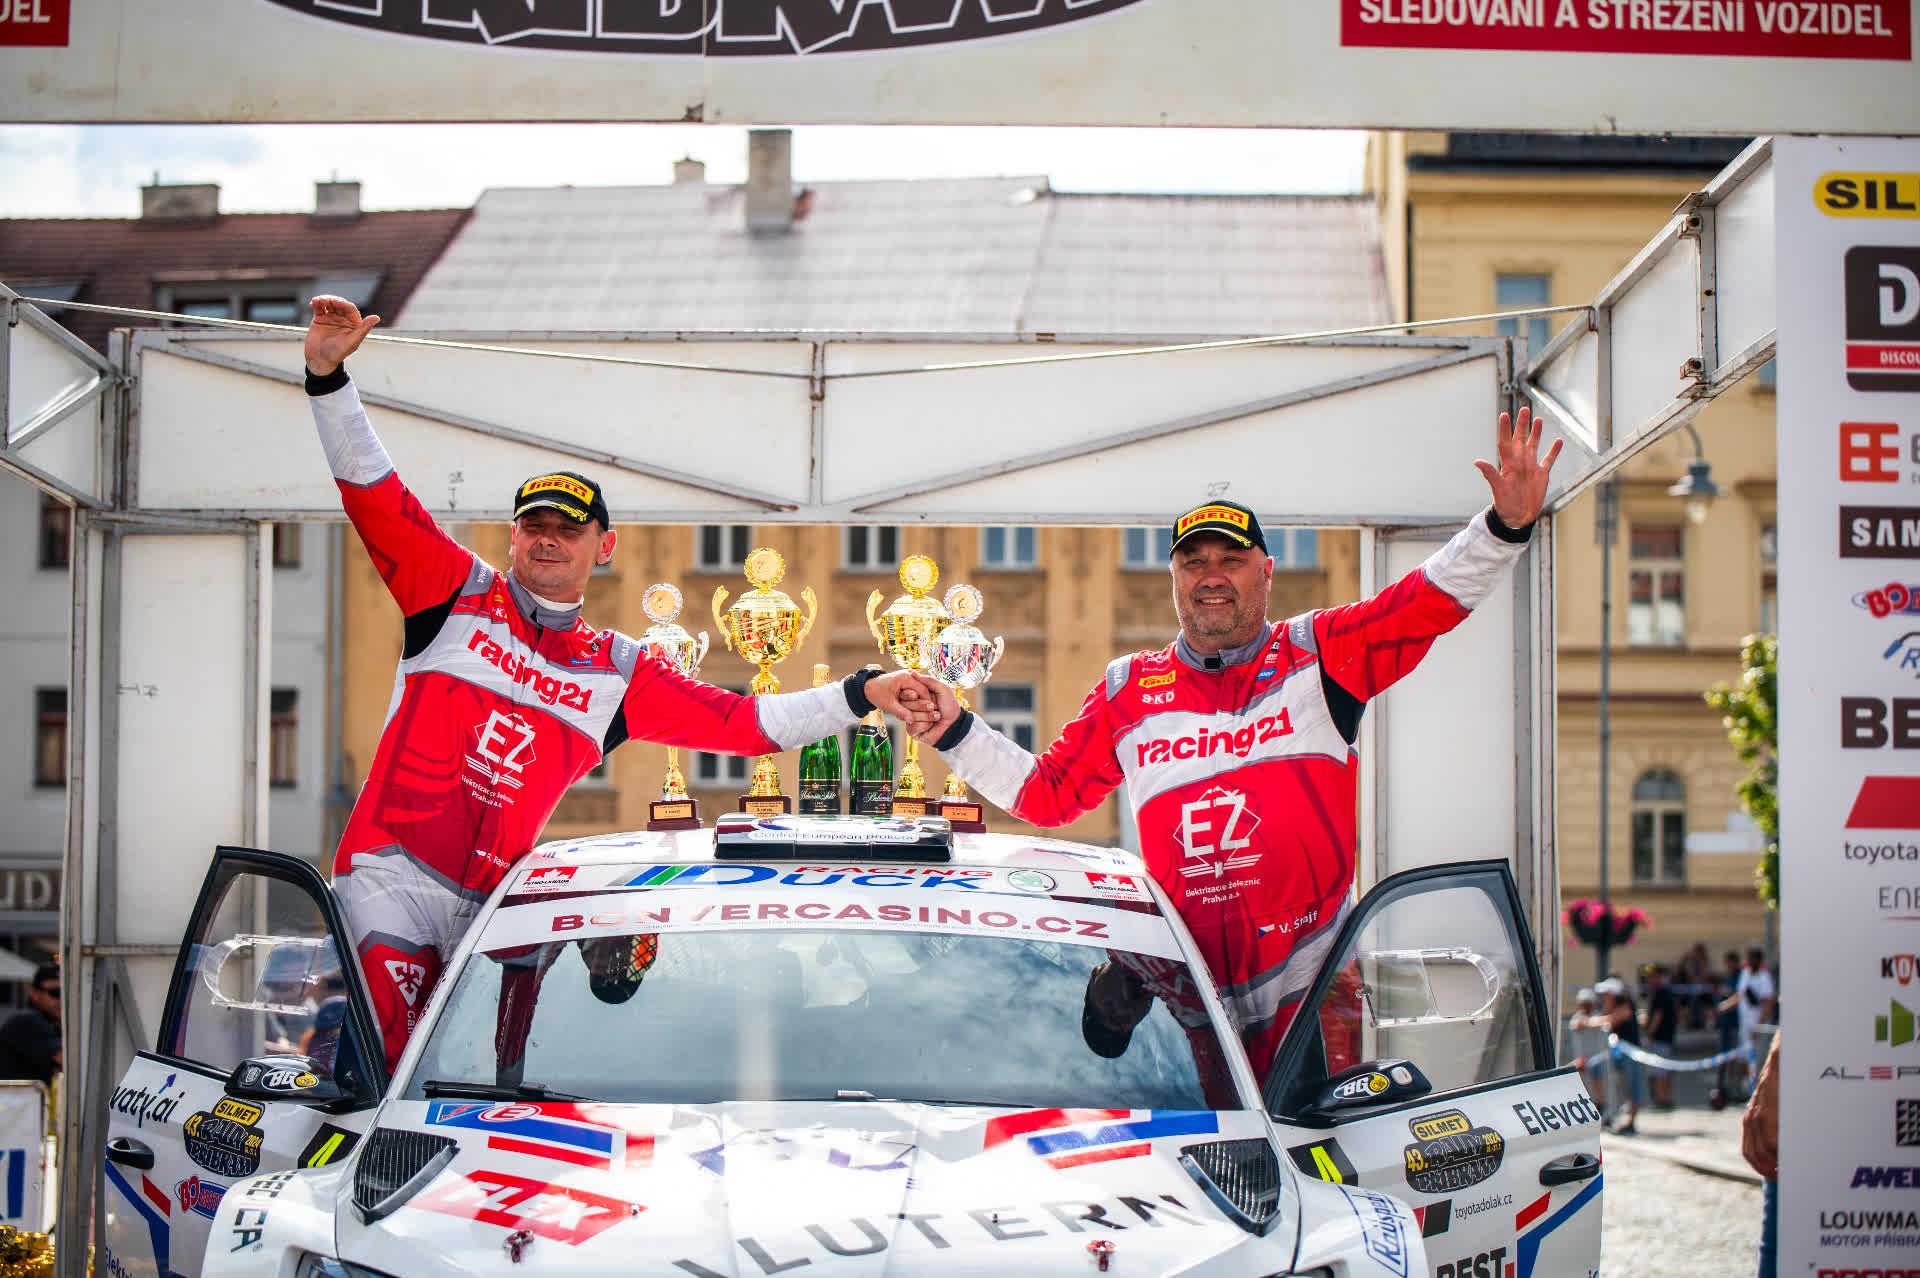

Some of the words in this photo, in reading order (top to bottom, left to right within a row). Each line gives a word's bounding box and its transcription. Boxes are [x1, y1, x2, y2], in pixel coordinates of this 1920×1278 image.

[1755, 1, 1893, 37] VOZIDEL
[1824, 179, 1920, 211] SIL
[1181, 509, 1244, 530] PIRELLI
[467, 628, 593, 713] racing21
[1136, 707, 1294, 768] racing21
[1843, 841, 1919, 864] toyota
[795, 866, 993, 877] RACING
[1278, 922, 1292, 934] V.
[1343, 1077, 1371, 1096] BG
[217, 1102, 257, 1122] SILMET
[1512, 1093, 1600, 1136] Elevat
[1416, 1118, 1463, 1138] SILMET
[1405, 1148, 1429, 1173] 43.
[1483, 1131, 1501, 1146] 2024
[1454, 1193, 1513, 1220] toyotadolak.cz
[1820, 1235, 1870, 1247] MOTOR
